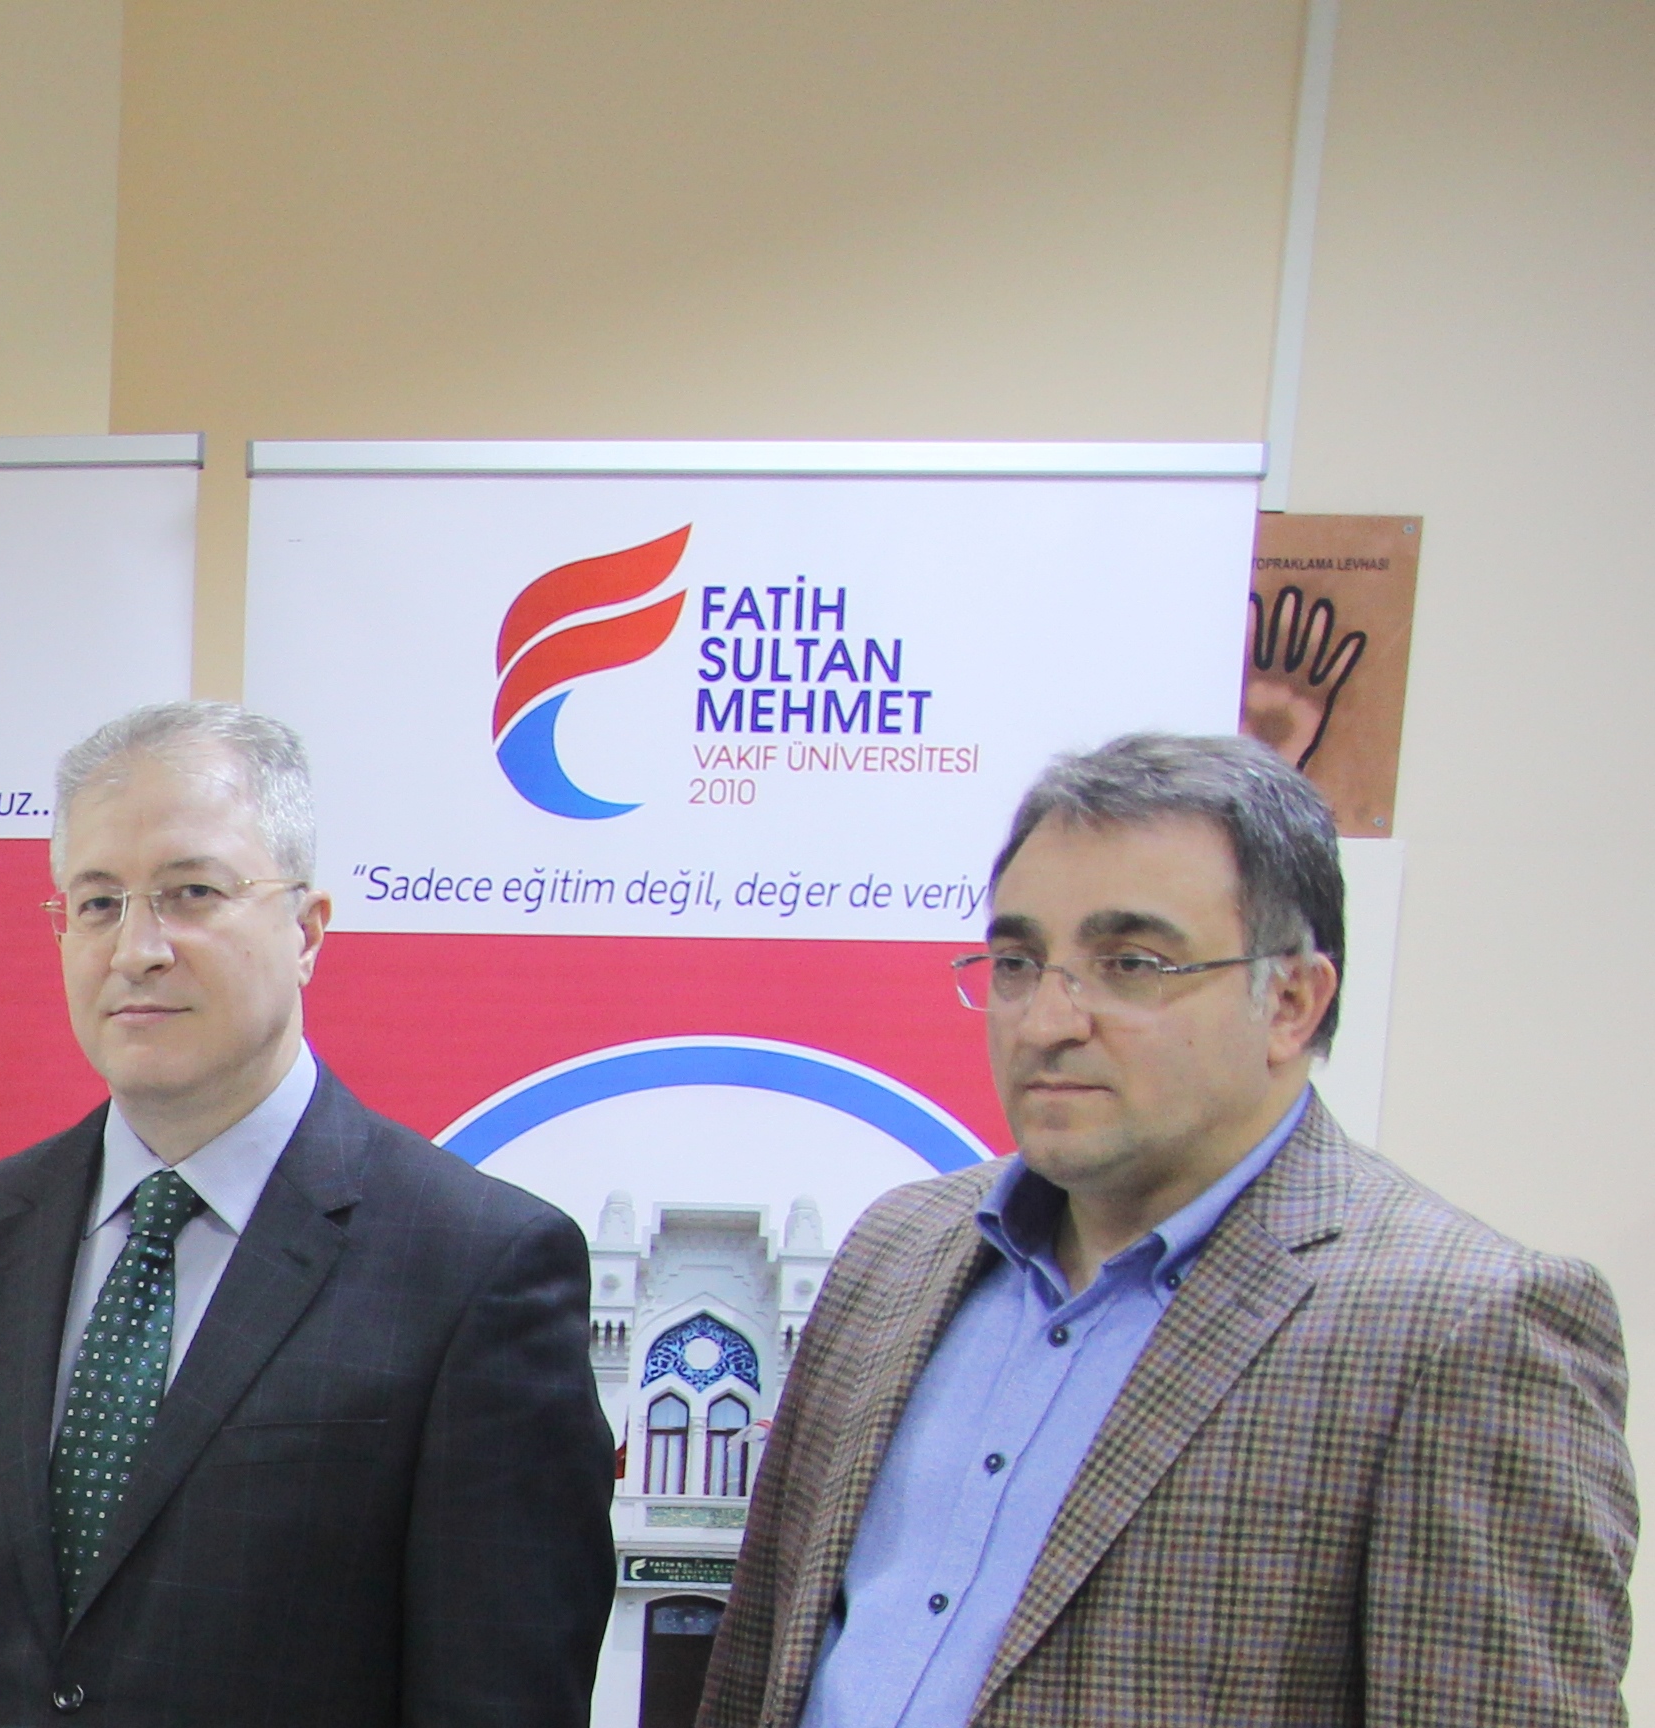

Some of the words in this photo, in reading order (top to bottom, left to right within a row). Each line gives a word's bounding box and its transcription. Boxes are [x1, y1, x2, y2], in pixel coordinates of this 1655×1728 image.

[1336, 557, 1390, 571] LEVHASI
[701, 575, 846, 631] FATİH
[698, 637, 903, 683] SULTAN
[695, 688, 932, 734] MEHMET
[692, 744, 778, 771] VAKIF
[787, 741, 979, 773] ÜNİVERSİTESİ
[689, 777, 756, 805] 2010
[502, 867, 615, 913] eğitim
[624, 870, 722, 917] değil,
[733, 871, 841, 919] değer
[849, 875, 892, 910] de
[902, 881, 987, 919] veriy
